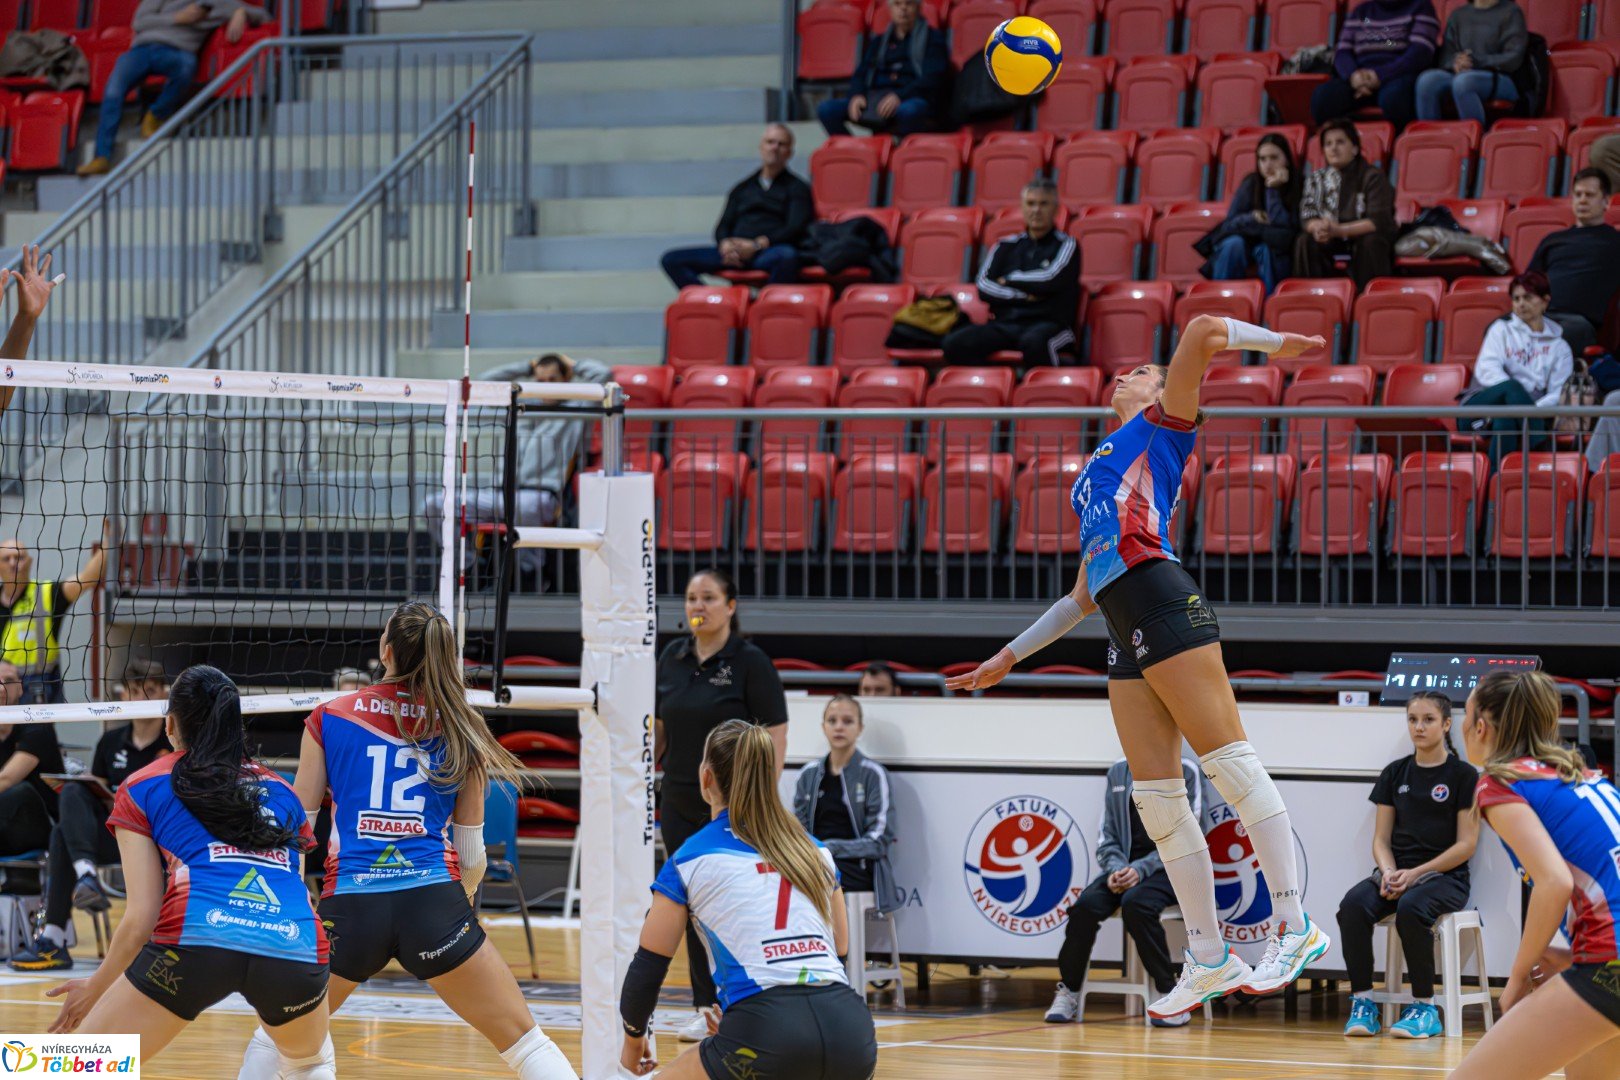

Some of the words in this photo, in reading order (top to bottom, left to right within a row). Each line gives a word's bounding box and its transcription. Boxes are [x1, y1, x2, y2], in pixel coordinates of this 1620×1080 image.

[353, 698, 368, 712] A.
[366, 745, 430, 811] 12
[995, 799, 1057, 820] FATUM
[359, 819, 425, 834] STRABAG
[755, 861, 793, 930] 7
[228, 899, 267, 911] KE-VIZ
[268, 905, 281, 914] 21
[763, 939, 827, 959] STRABAG
